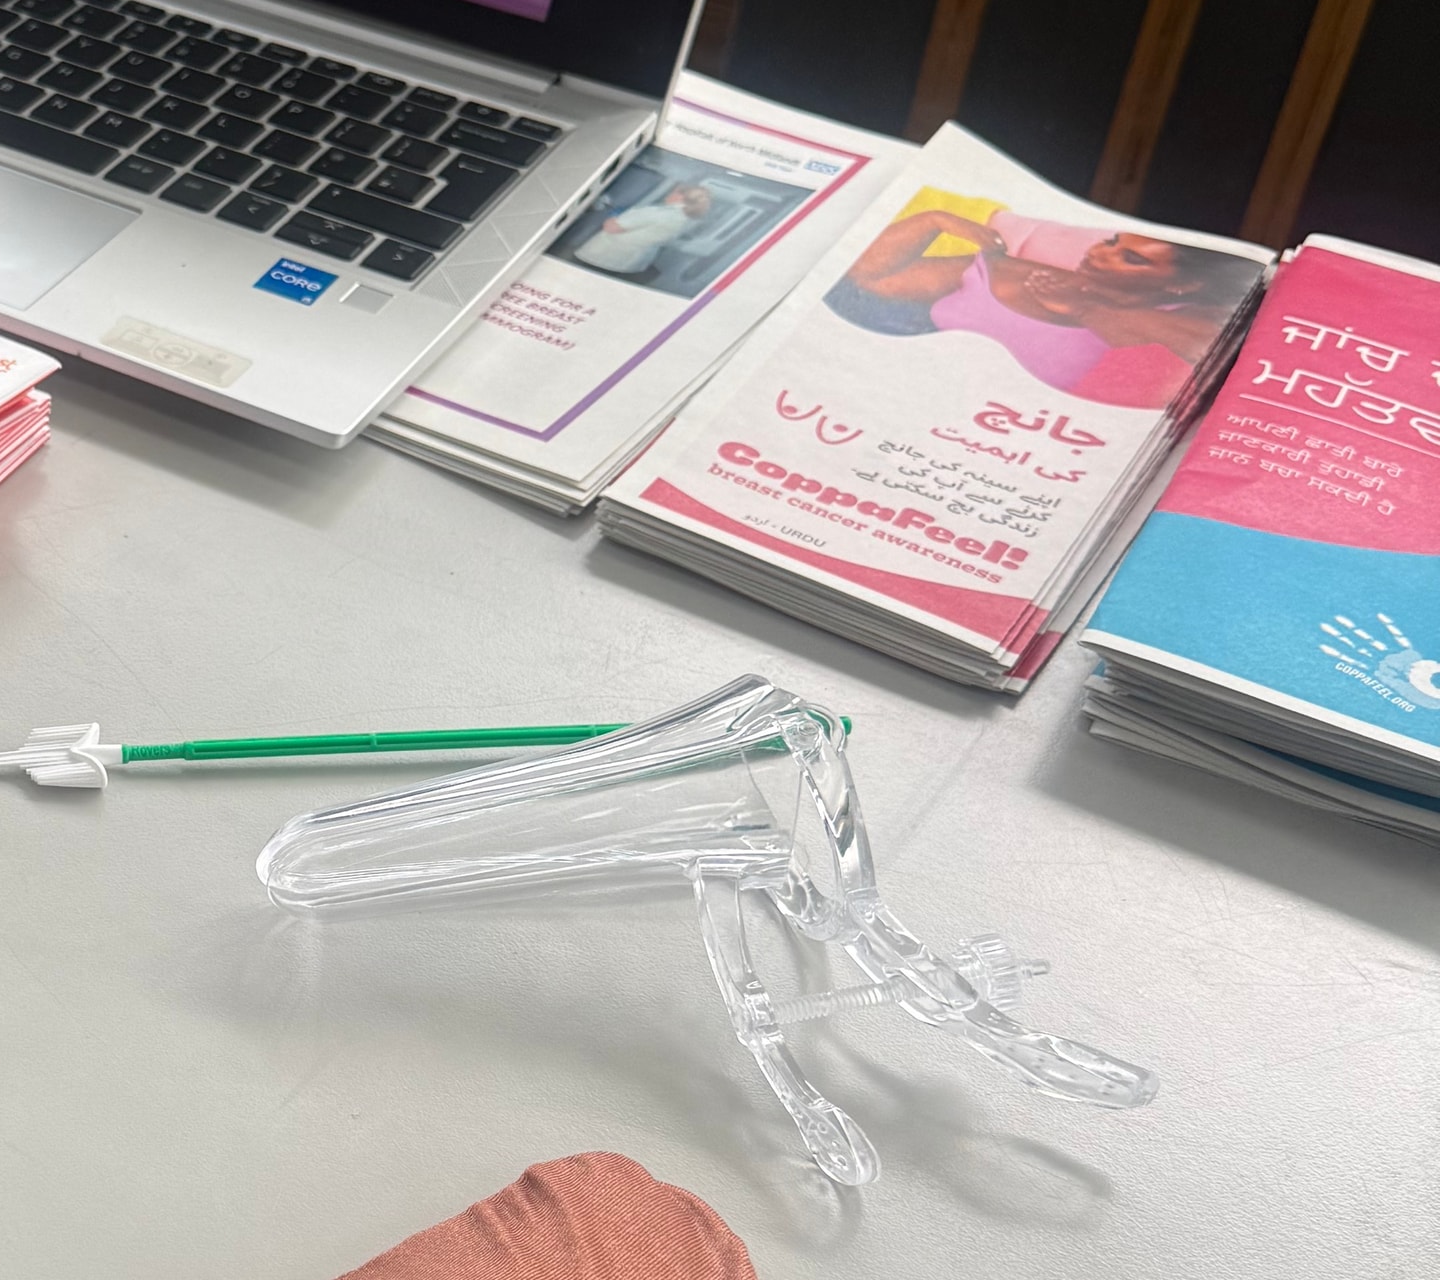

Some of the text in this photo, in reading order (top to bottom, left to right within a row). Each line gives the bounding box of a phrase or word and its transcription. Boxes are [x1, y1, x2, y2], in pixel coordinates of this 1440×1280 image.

[490, 303, 567, 333] CREENING
[510, 282, 551, 300] OING
[551, 297, 583, 312] FOR
[526, 302, 586, 325] BREAST
[1281, 315, 1410, 372] ਜਾਂਚ
[973, 401, 1106, 455] جانچ
[1218, 429, 1312, 465] ਜਾਣਕਾਰੀ
[1226, 414, 1406, 479] ਆਪਣੀ ਛਾਤੀ ਬਾਰੇ
[877, 439, 1062, 510] اپنے سینہ کی جانچ
[897, 464, 932, 478] کی
[930, 426, 1087, 483] کی اہمیت
[933, 474, 964, 491] آپ
[965, 491, 1003, 506] سے
[1208, 446, 1397, 516] ਜਾਨ ਬਚਾ ਸਕਦੀ ਹੈ
[707, 461, 1003, 585] breast cancer awareness
[716, 440, 1029, 572] CoppaFeel!
[978, 512, 1039, 538] زندگی
[780, 525, 827, 548] URDU
[1335, 662, 1416, 713] COPPAFEEL.ORG
